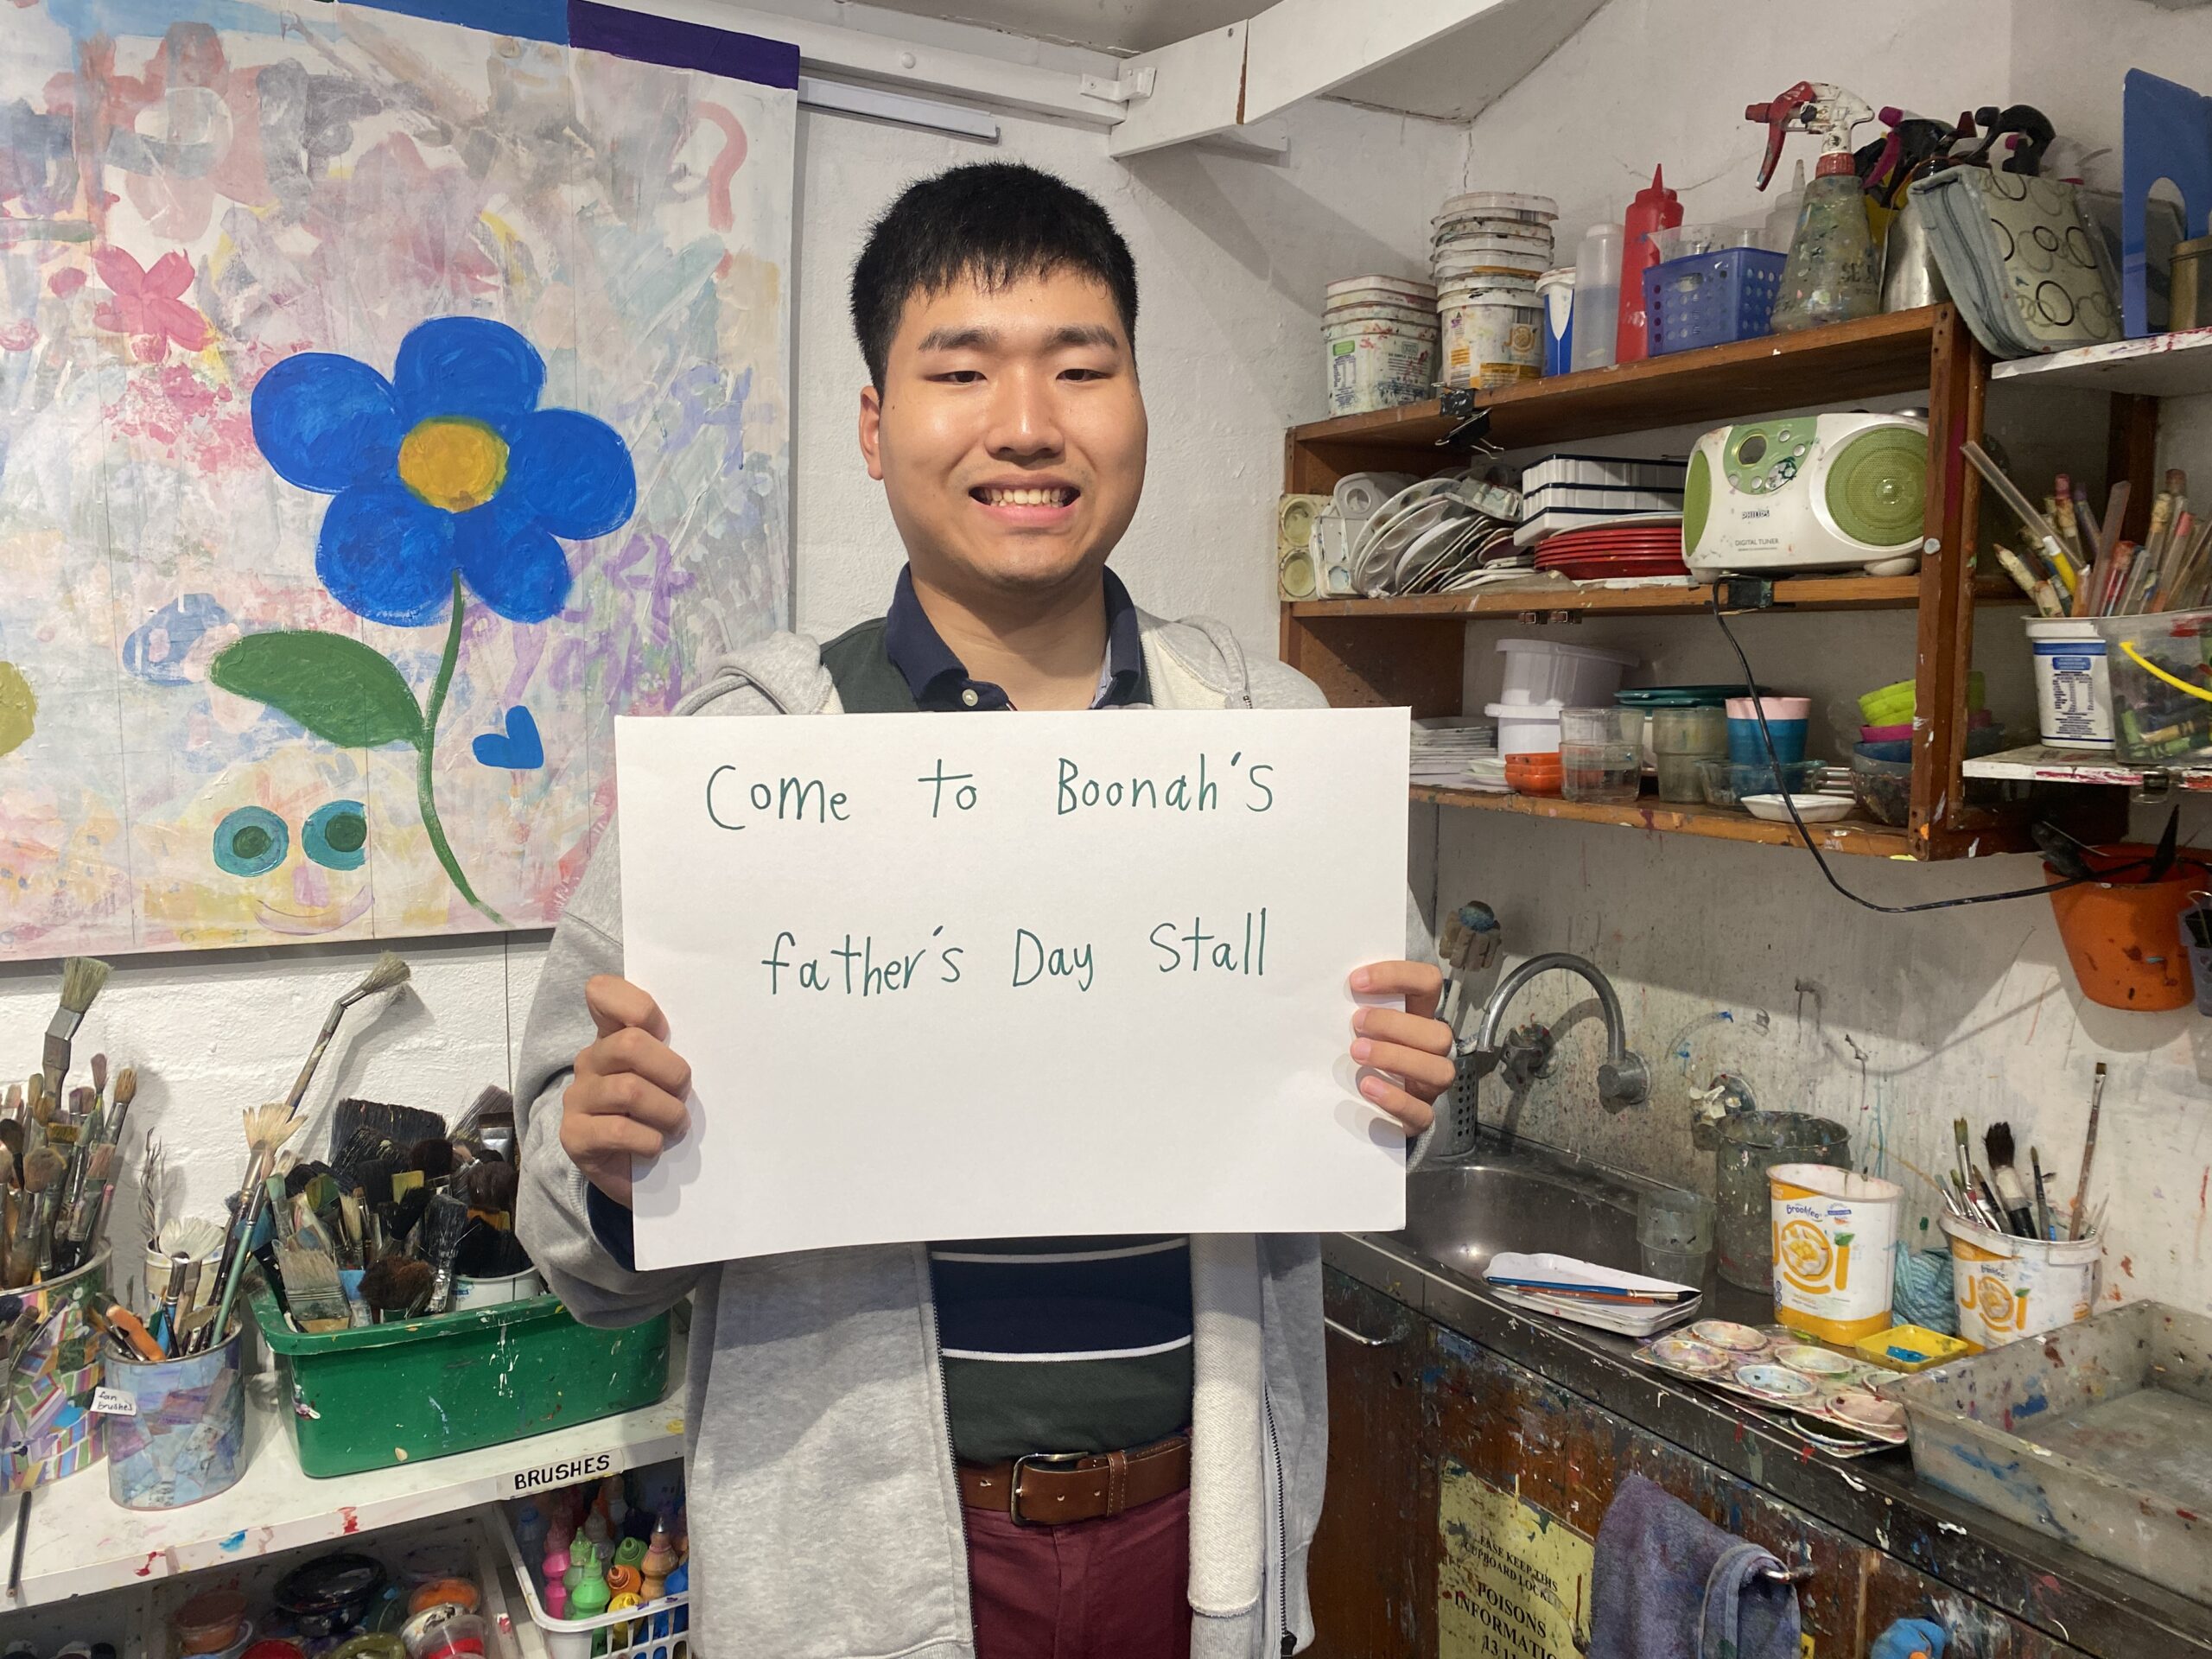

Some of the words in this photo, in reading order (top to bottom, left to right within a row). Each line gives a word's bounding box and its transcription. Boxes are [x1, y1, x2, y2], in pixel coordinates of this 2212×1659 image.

[1734, 538, 1758, 547] DIGITAL
[707, 765, 850, 830] Come
[918, 758, 977, 818] to
[761, 925, 964, 996] father's
[1013, 927, 1095, 992] Day
[1149, 906, 1268, 976] Stall
[514, 1454, 610, 1491] BRUSHES
[1464, 1541, 1517, 1581] CUPBOARD
[1506, 1551, 1533, 1574] KEEP
[1477, 1580, 1548, 1639] POISONS
